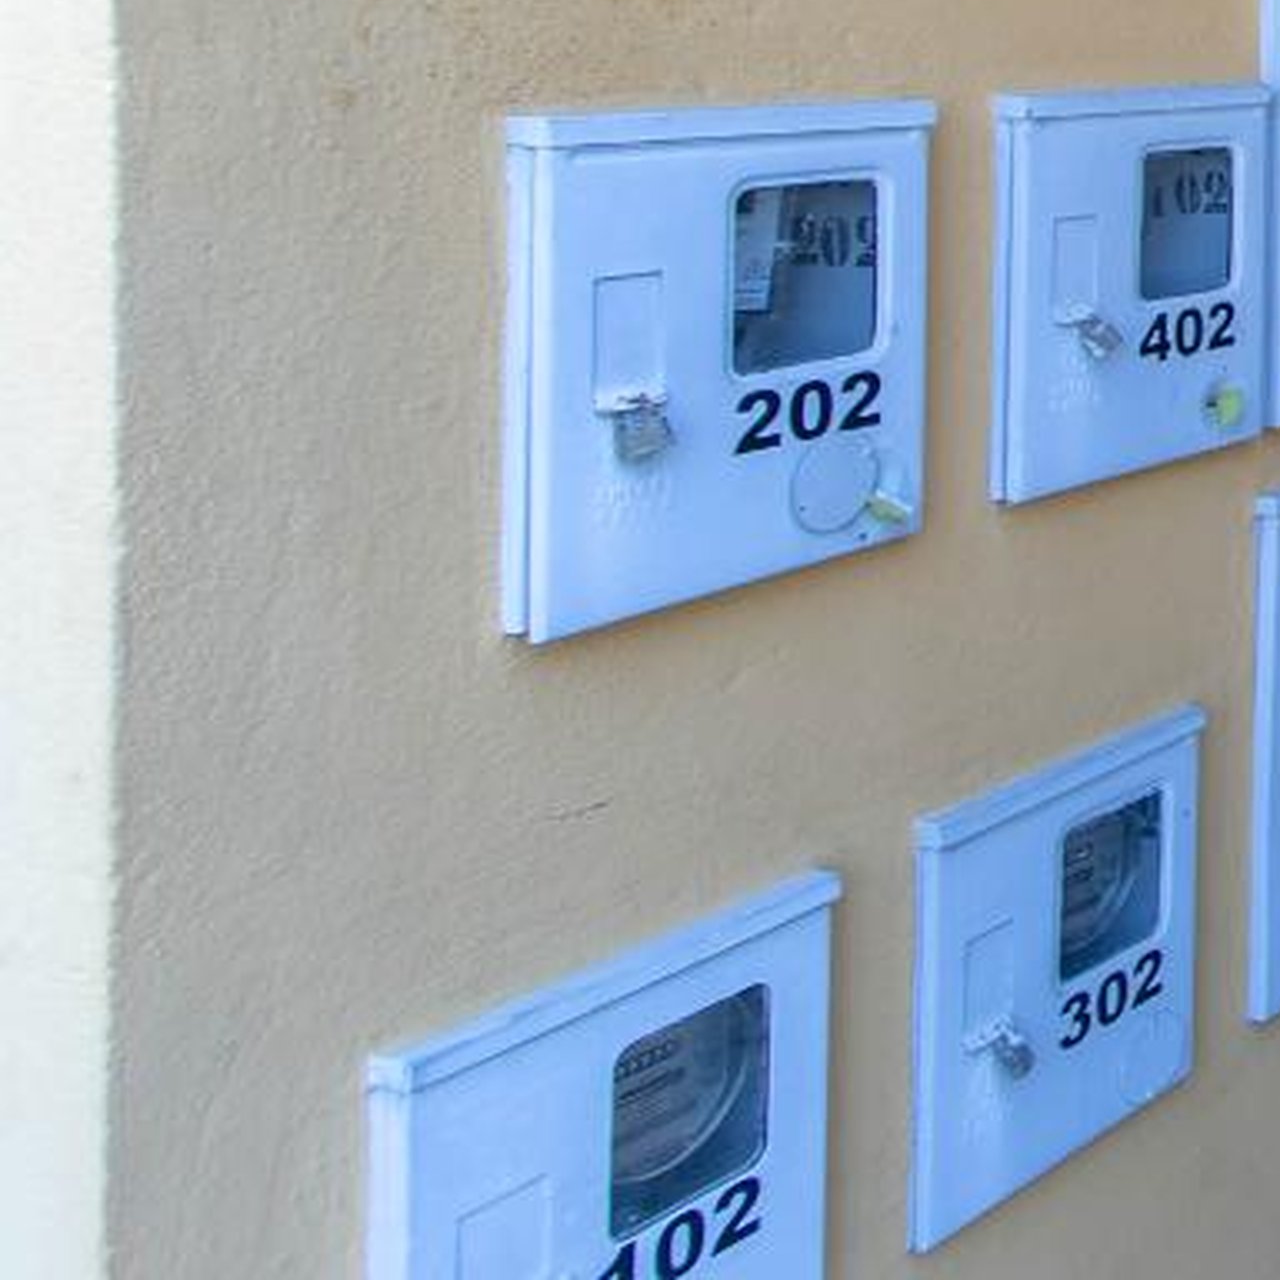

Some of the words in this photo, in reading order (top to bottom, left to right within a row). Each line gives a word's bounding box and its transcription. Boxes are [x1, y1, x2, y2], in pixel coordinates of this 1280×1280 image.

[1139, 301, 1236, 362] 402
[734, 369, 882, 455] 202
[1059, 949, 1164, 1051] 302
